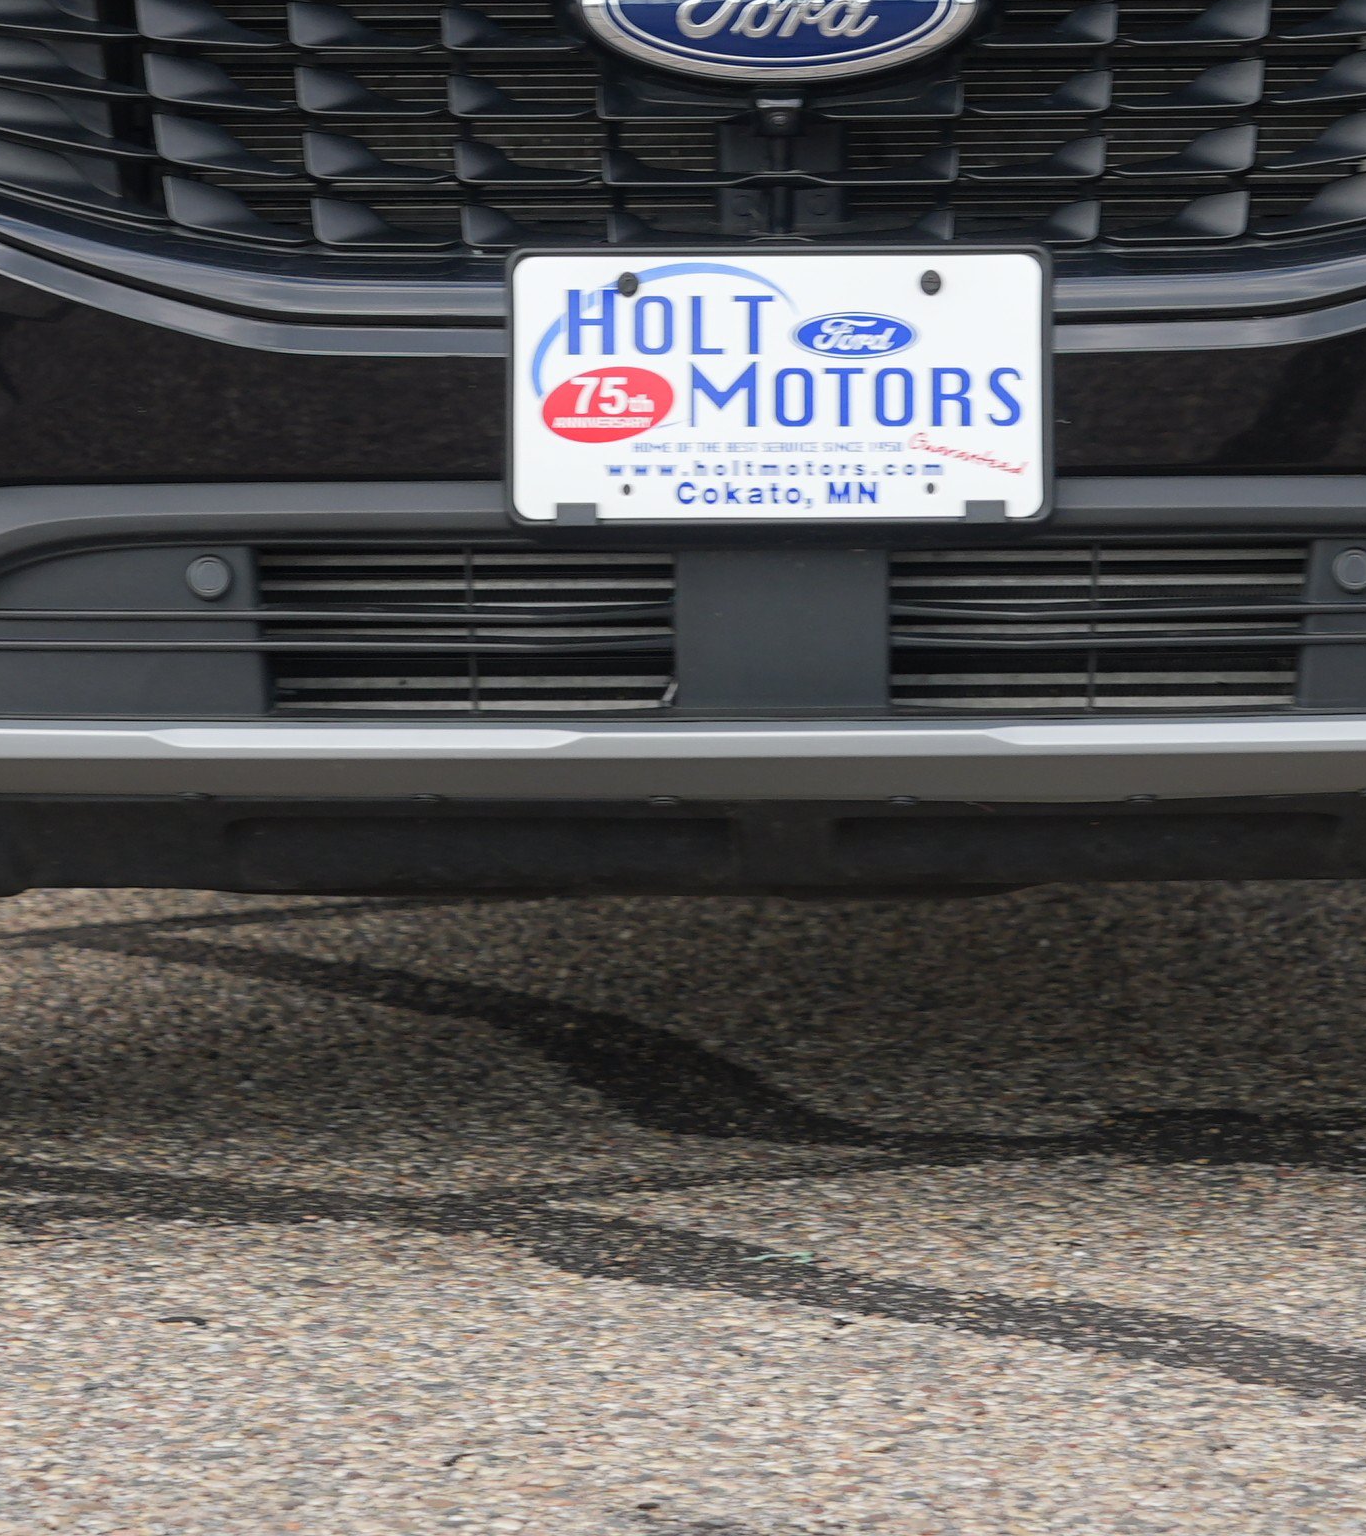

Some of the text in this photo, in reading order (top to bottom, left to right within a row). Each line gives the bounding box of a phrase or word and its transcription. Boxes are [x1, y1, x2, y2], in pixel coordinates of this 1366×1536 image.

[567, 289, 774, 355] HOLT
[812, 318, 897, 351] Ford
[570, 376, 655, 415] 75th
[690, 362, 1023, 428] MOTORS
[633, 442, 672, 452] HOME
[677, 442, 692, 452] OF
[697, 442, 720, 452] THE
[727, 442, 758, 452] BEST
[762, 442, 819, 452] SERVICE
[823, 442, 863, 452] SINCE
[606, 460, 944, 476] www.holtmotors.com
[676, 481, 878, 508] Cokato, MN
